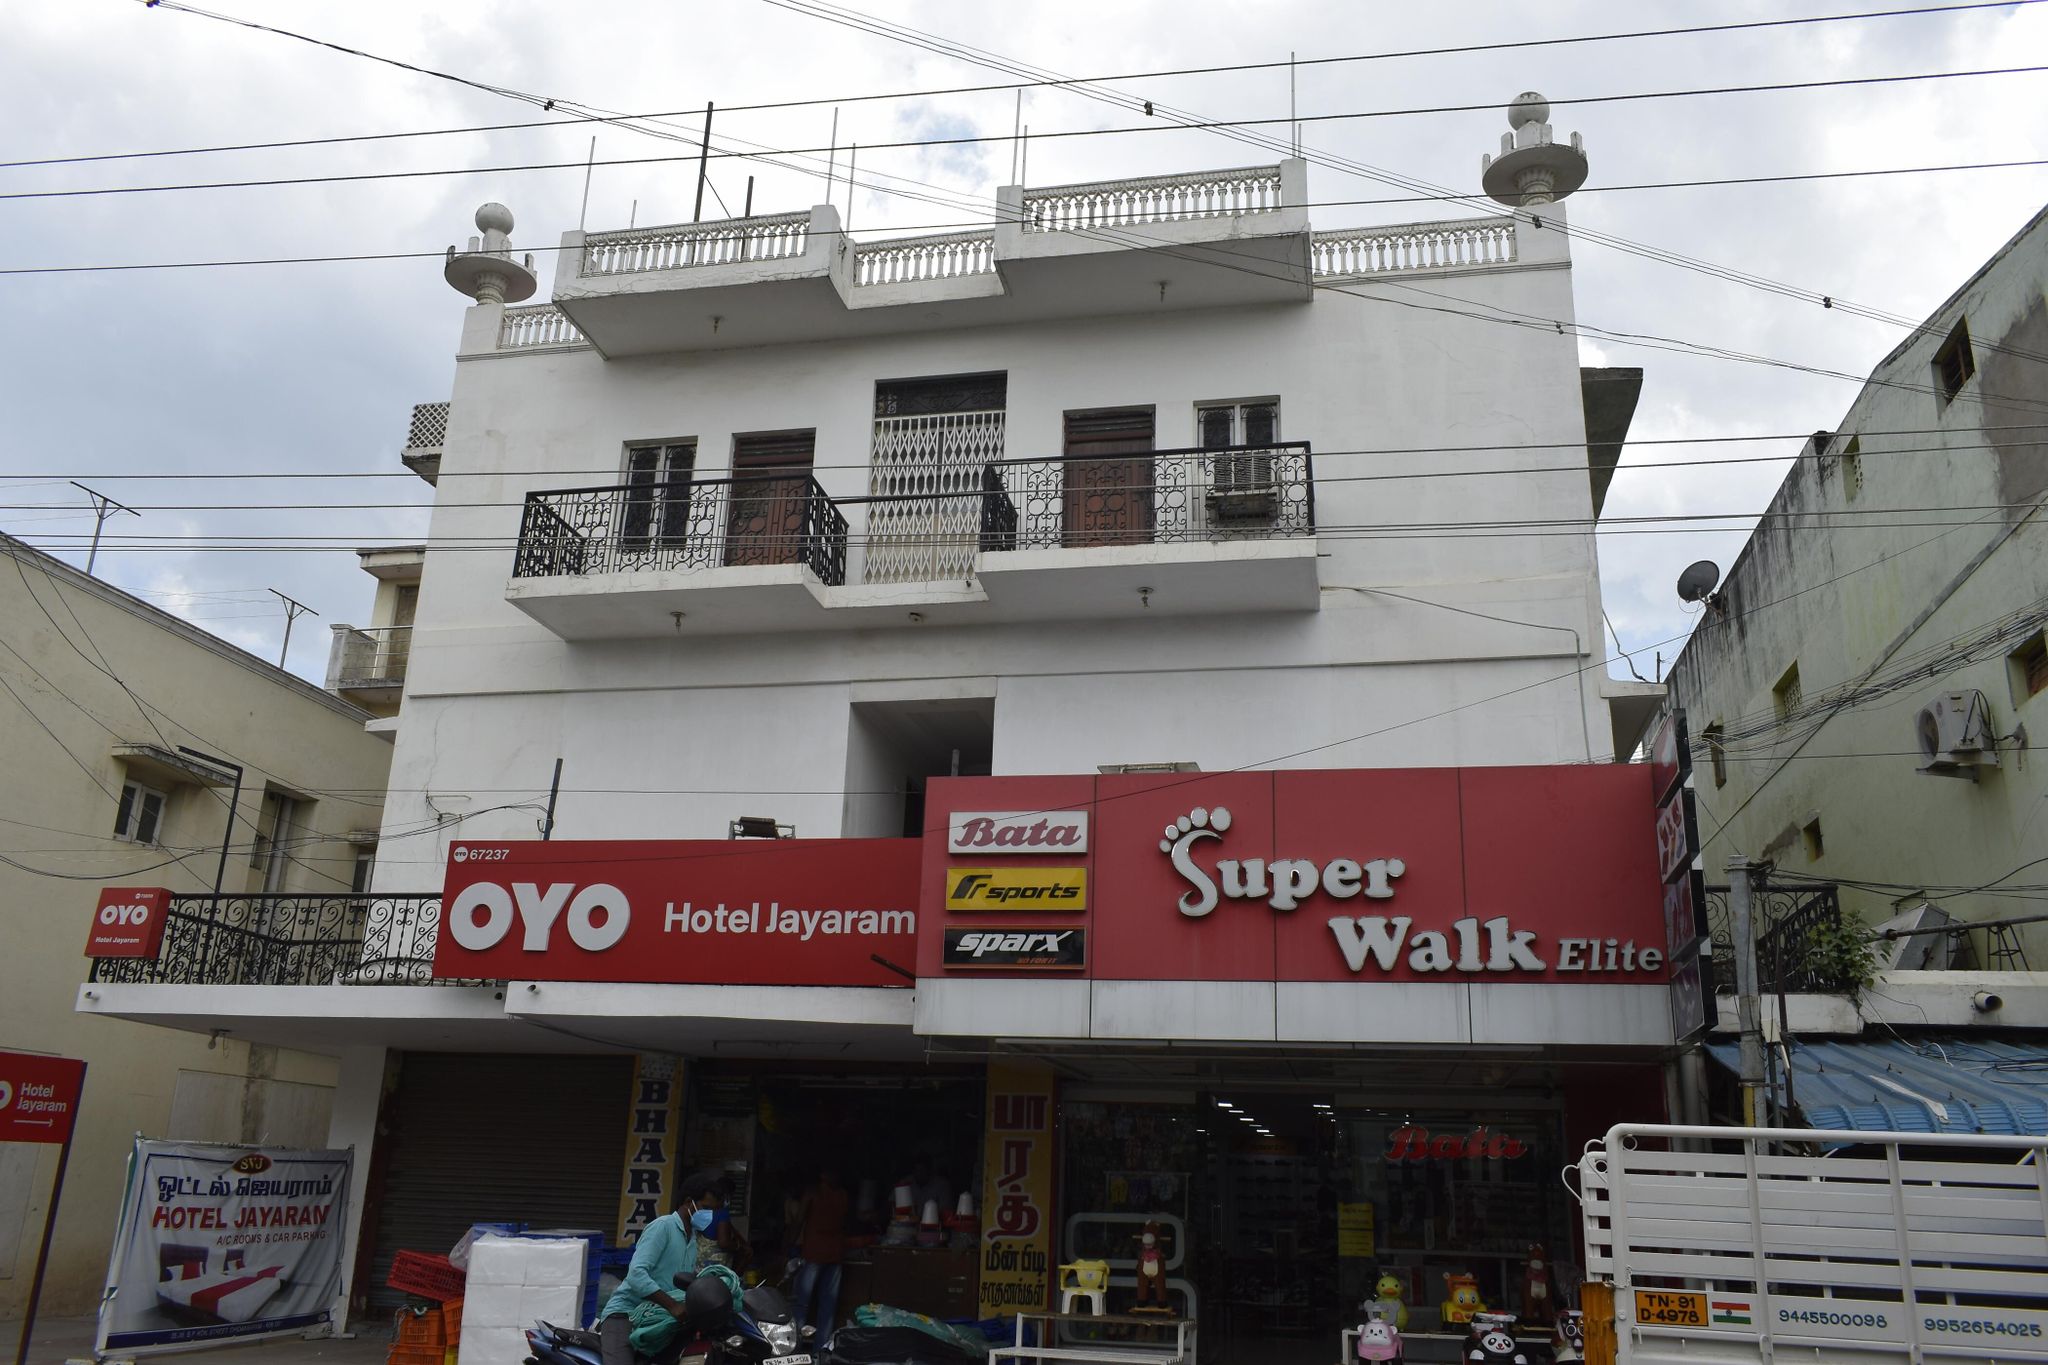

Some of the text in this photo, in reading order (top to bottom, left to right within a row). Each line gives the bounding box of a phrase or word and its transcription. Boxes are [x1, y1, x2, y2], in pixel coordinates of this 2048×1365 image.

[954, 817, 1081, 847] Bata
[470, 849, 510, 860] 67237
[1171, 828, 1406, 918] Super
[985, 883, 1080, 902] sports
[100, 905, 149, 925] OYO
[449, 881, 916, 952] OYO Hotel Jayaram
[113, 937, 140, 945] Jayaram
[955, 930, 1075, 957] sparx
[1328, 915, 1665, 973] Walk Elite
[21, 1082, 55, 1097] Hotel
[17, 1096, 67, 1113] Jayaram
[1384, 1126, 1528, 1160] Bata
[240, 1157, 264, 1170] SVJ
[235, 1174, 333, 1199] ஜெயராம்
[152, 1205, 228, 1229] HOTEL
[216, 1234, 232, 1245] A/C
[233, 1233, 262, 1245] ROOMS
[264, 1233, 270, 1243] &
[272, 1232, 290, 1243] CAR
[1678, 1296, 1696, 1309] 91
[1640, 1308, 1700, 1324] D-4978
[1778, 1309, 1888, 1328] 9445500098
[1923, 1318, 2043, 1337] 9952654025
